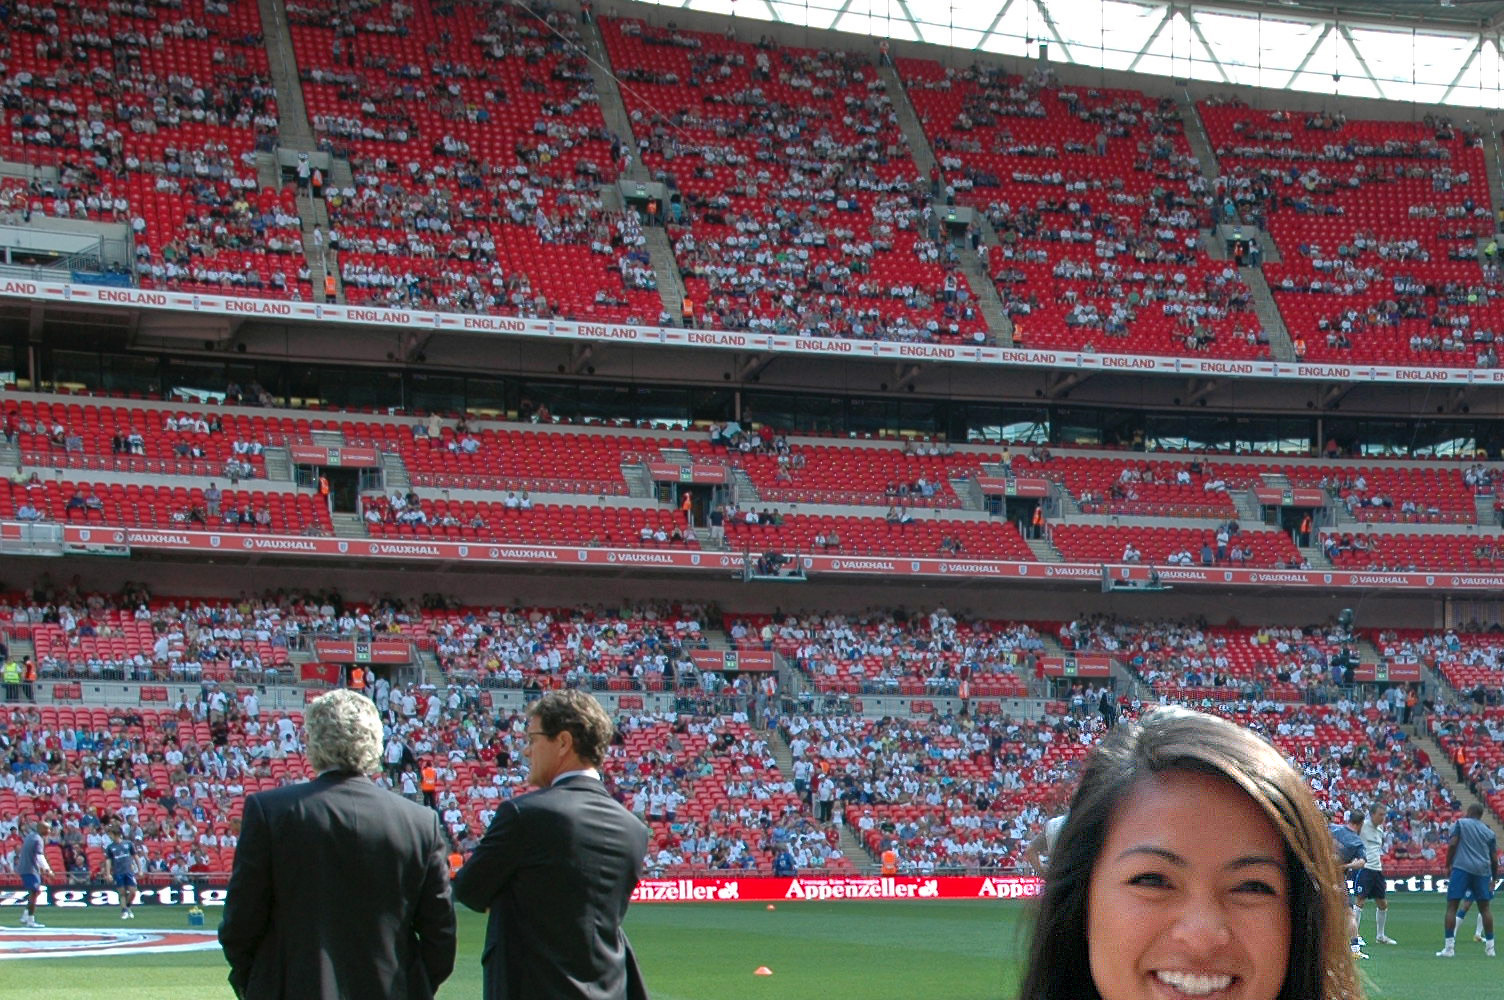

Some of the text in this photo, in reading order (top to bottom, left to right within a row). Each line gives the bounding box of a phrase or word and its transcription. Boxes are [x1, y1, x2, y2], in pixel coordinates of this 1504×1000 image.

[0, 281, 37, 295] AND
[98, 290, 167, 306] ENGLAND
[225, 300, 291, 315] ENGLAND
[347, 309, 411, 323] ENGLAND
[464, 318, 526, 332] ENGLAND
[577, 325, 638, 339] ENGLAND
[687, 332, 746, 346] ENGLAND
[796, 339, 852, 352] ENGLAND
[899, 345, 955, 358] ENGLAND
[1002, 351, 1056, 364] ENGLAND
[1102, 357, 1155, 369] ENGLAND
[1200, 362, 1253, 374] ENGLAND
[1298, 366, 1350, 377] ENGLAND
[1395, 369, 1448, 381] ENGLAND
[127, 534, 190, 545] VAUXHALL
[255, 538, 316, 550] VAUXHALL
[381, 544, 440, 556] VAUXHALL
[500, 549, 557, 560] VAUXHALL
[617, 553, 674, 564] VAUXHALL
[841, 560, 895, 570] VAUXHALL
[948, 563, 1000, 573] VAUXHALL
[1259, 573, 1309, 582] VAUXHALL
[1359, 575, 1408, 585] VAUXHALL
[785, 878, 919, 900] Appenzeller
